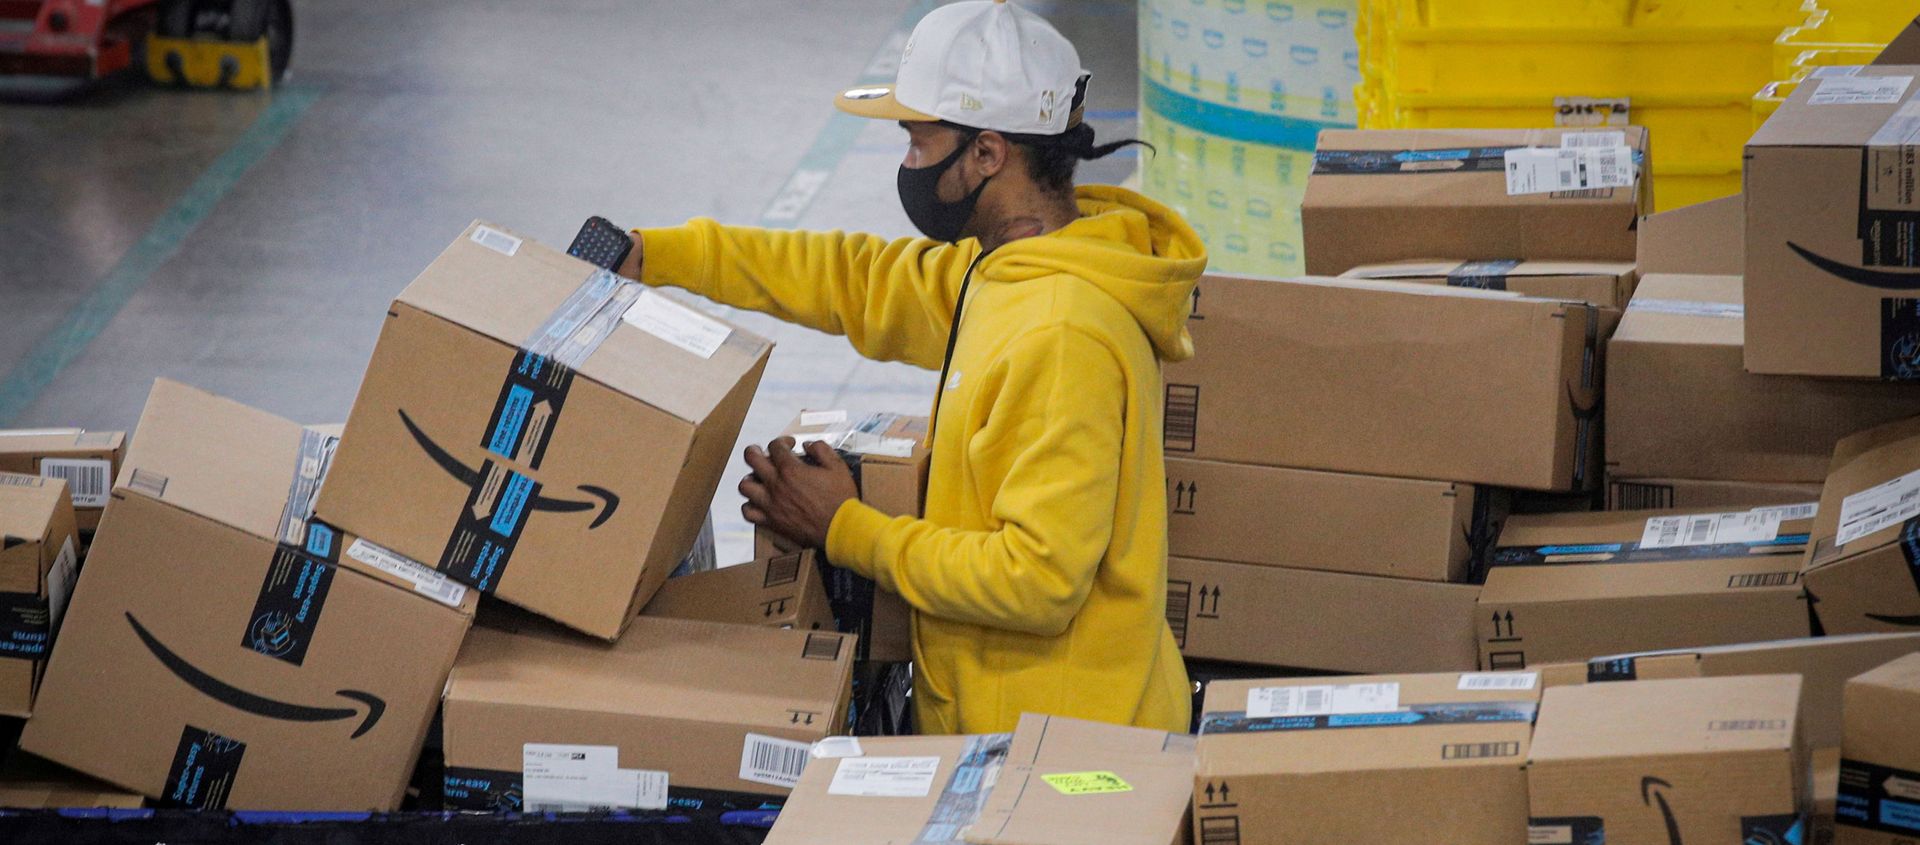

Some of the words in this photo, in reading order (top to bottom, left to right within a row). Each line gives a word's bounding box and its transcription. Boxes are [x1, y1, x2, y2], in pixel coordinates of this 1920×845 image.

[1904, 168, 1915, 205] million
[292, 559, 313, 599] returns
[470, 540, 492, 579] returns
[295, 562, 326, 623] Super-easy
[172, 742, 201, 800] Super-easy
[186, 766, 205, 805] returns
